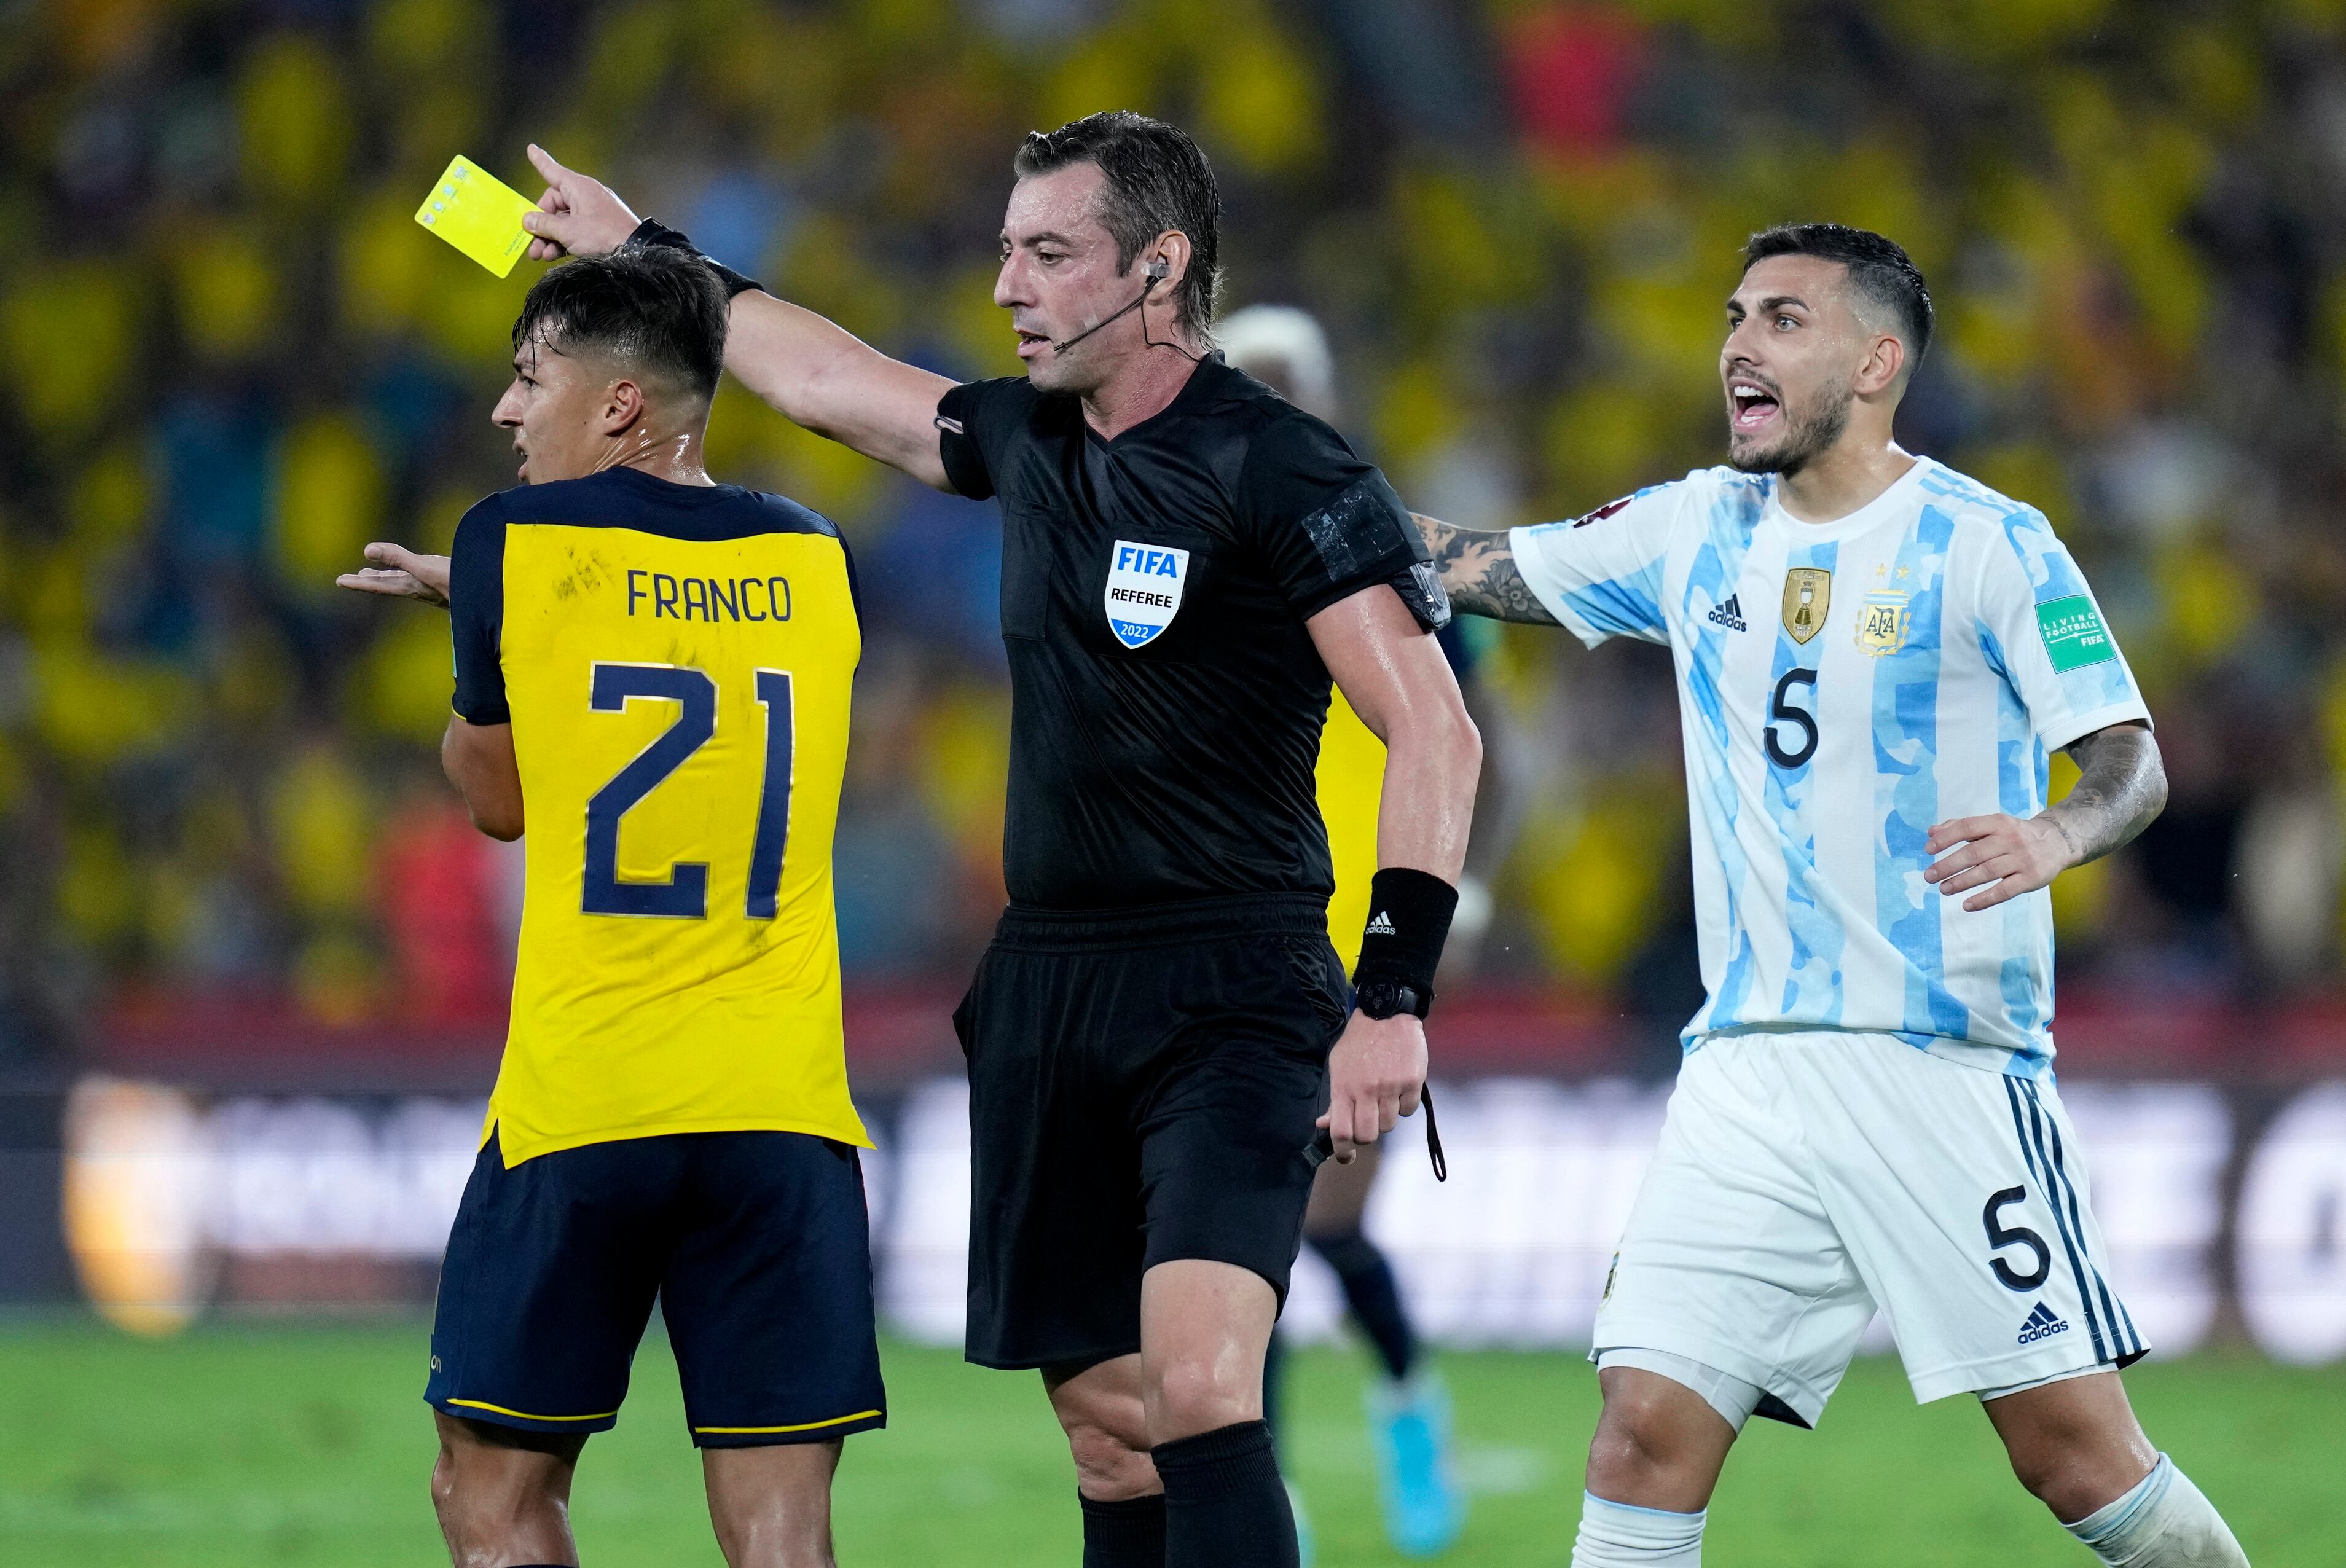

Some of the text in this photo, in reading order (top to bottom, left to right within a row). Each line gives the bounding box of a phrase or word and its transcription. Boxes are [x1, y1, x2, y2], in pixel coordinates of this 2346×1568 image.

[1118, 547, 1177, 578] FIFA
[627, 569, 792, 622] FRANCO
[1111, 587, 1174, 608] REFEREE
[1120, 624, 1149, 638] 2022
[1708, 611, 1747, 632] adidas
[1865, 606, 1895, 639] AFA
[2043, 613, 2095, 631] LIVING
[2046, 621, 2098, 639] FOOTBALL
[2081, 634, 2105, 647] FIFA
[1763, 668, 1819, 770] 5
[579, 659, 796, 920] 21
[1365, 924, 1396, 935] adidas
[1983, 1183, 2051, 1292] 5
[2018, 1320, 2069, 1344] adidas
